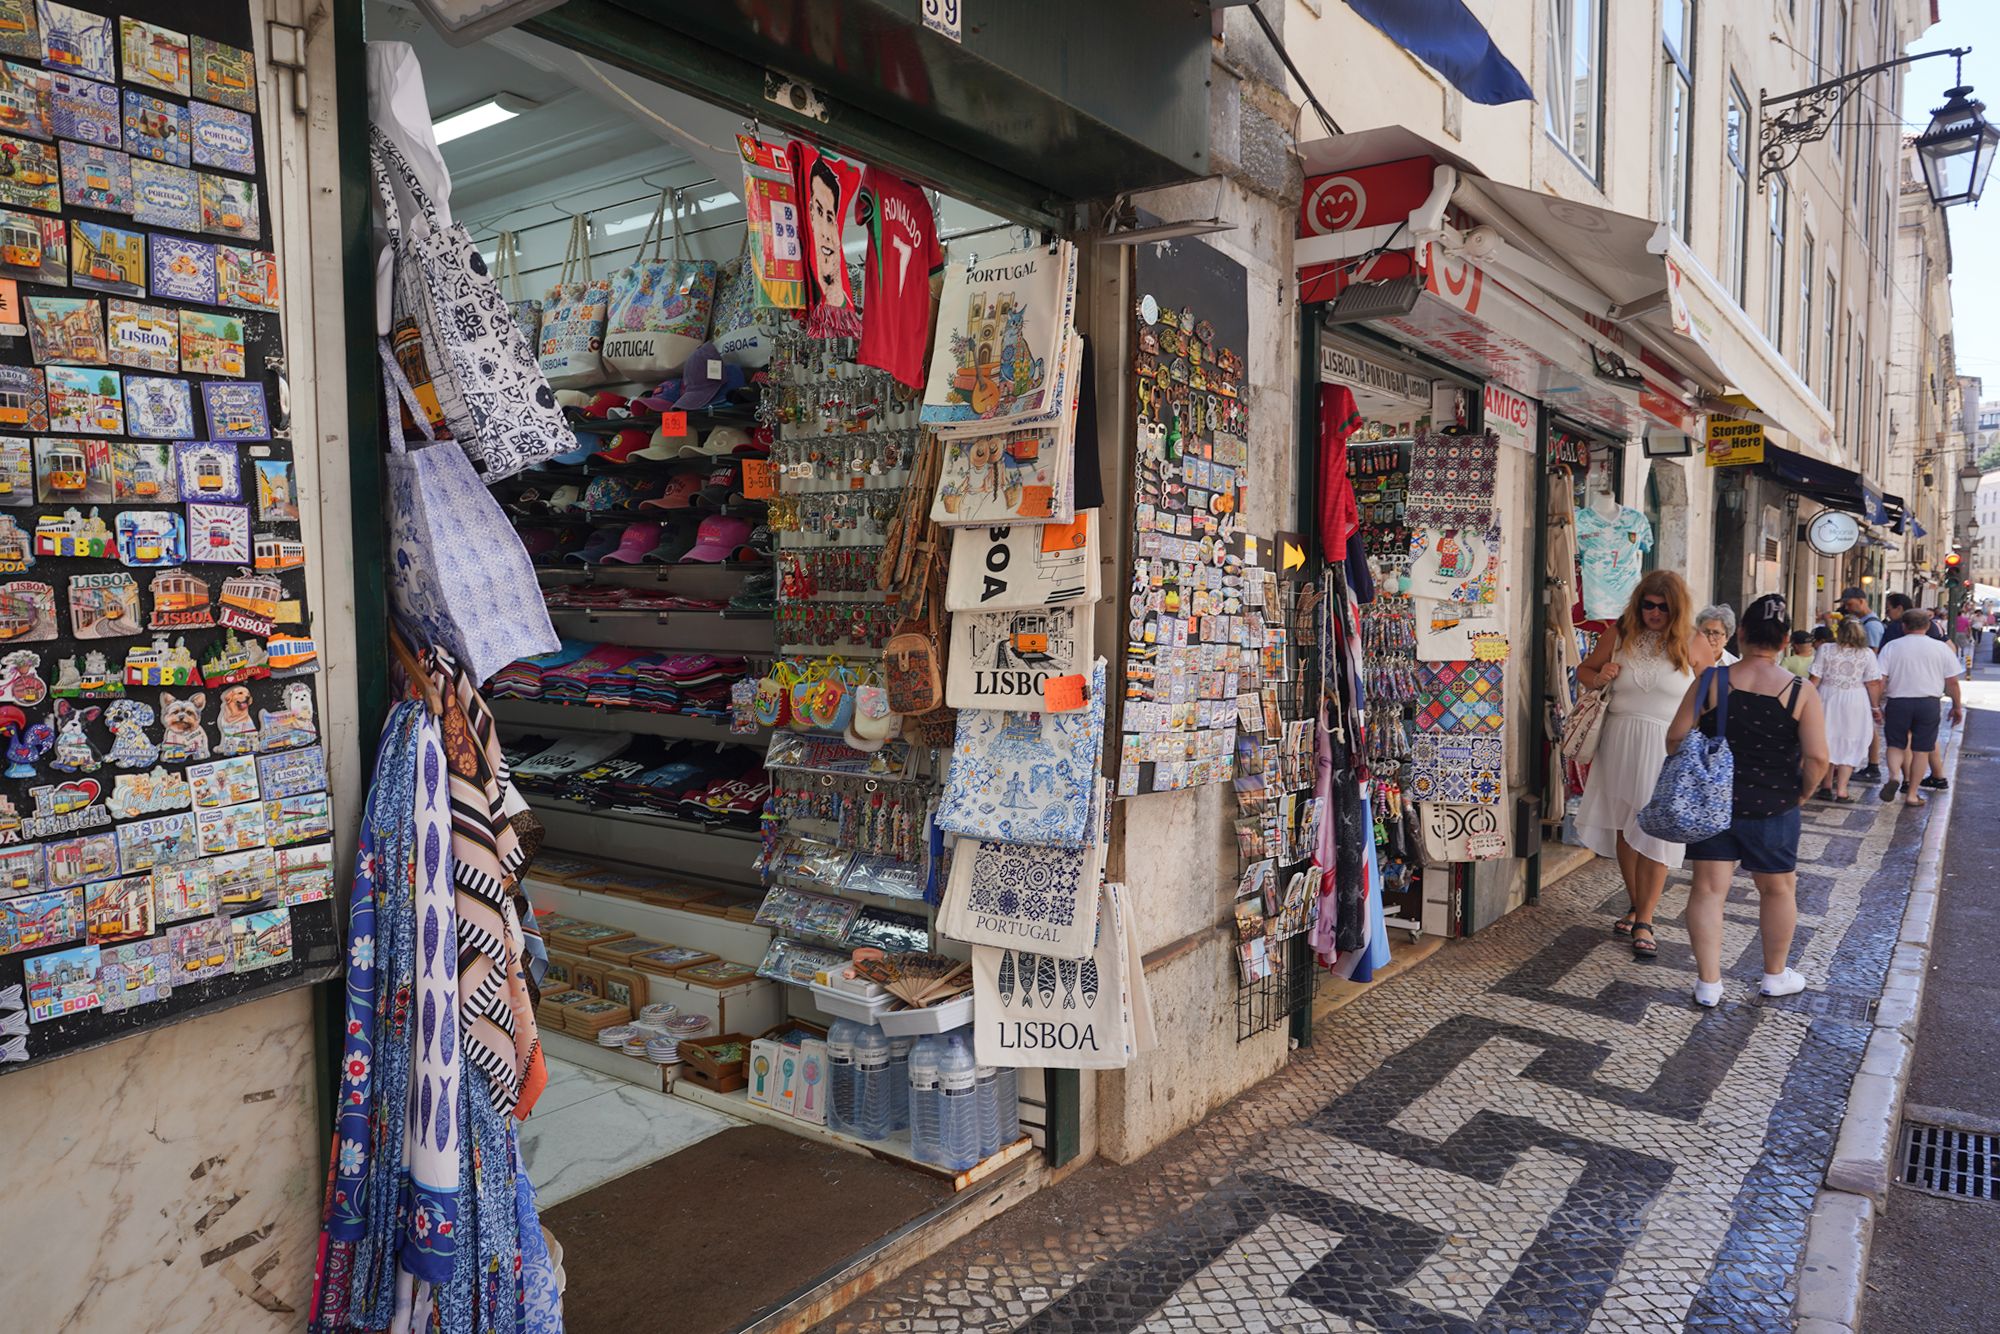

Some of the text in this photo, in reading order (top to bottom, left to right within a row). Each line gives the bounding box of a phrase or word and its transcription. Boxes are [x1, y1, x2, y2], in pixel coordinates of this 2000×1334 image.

[203, 128, 244, 145] PORTUGAL
[148, 189, 185, 203] PORTUGAL
[884, 198, 921, 248] RONALDO
[893, 235, 912, 297] 7
[966, 261, 1037, 284] PORTUGAL
[121, 329, 168, 348] LISBOA
[604, 340, 654, 358] ORTUGAL
[1323, 349, 1357, 379] LISBOA
[1365, 363, 1405, 395] PORTUGAL
[1484, 385, 1528, 429] AMIGO
[1711, 424, 1761, 438] Storage
[1731, 436, 1761, 449] Here
[36, 535, 120, 559] LISBOA
[1611, 550, 1618, 568] 7
[9, 582, 47, 592] LISBOA
[72, 573, 134, 589] LISBOA
[151, 610, 215, 625] LISBOA
[220, 607, 273, 636] LISBOA
[127, 666, 203, 686] LISBOA
[296, 665, 319, 675] LISBOA
[973, 671, 1064, 696] LISBO
[276, 768, 311, 781] LISBOA
[21, 804, 112, 838] PORTUGAL
[119, 814, 191, 840] LISBOA
[881, 869, 916, 883] LISBOA
[283, 889, 324, 906] LISBOA
[976, 915, 1061, 943] PORTUGAL
[36, 993, 99, 1020] LISBOA
[998, 1022, 1099, 1051] LISBOA
